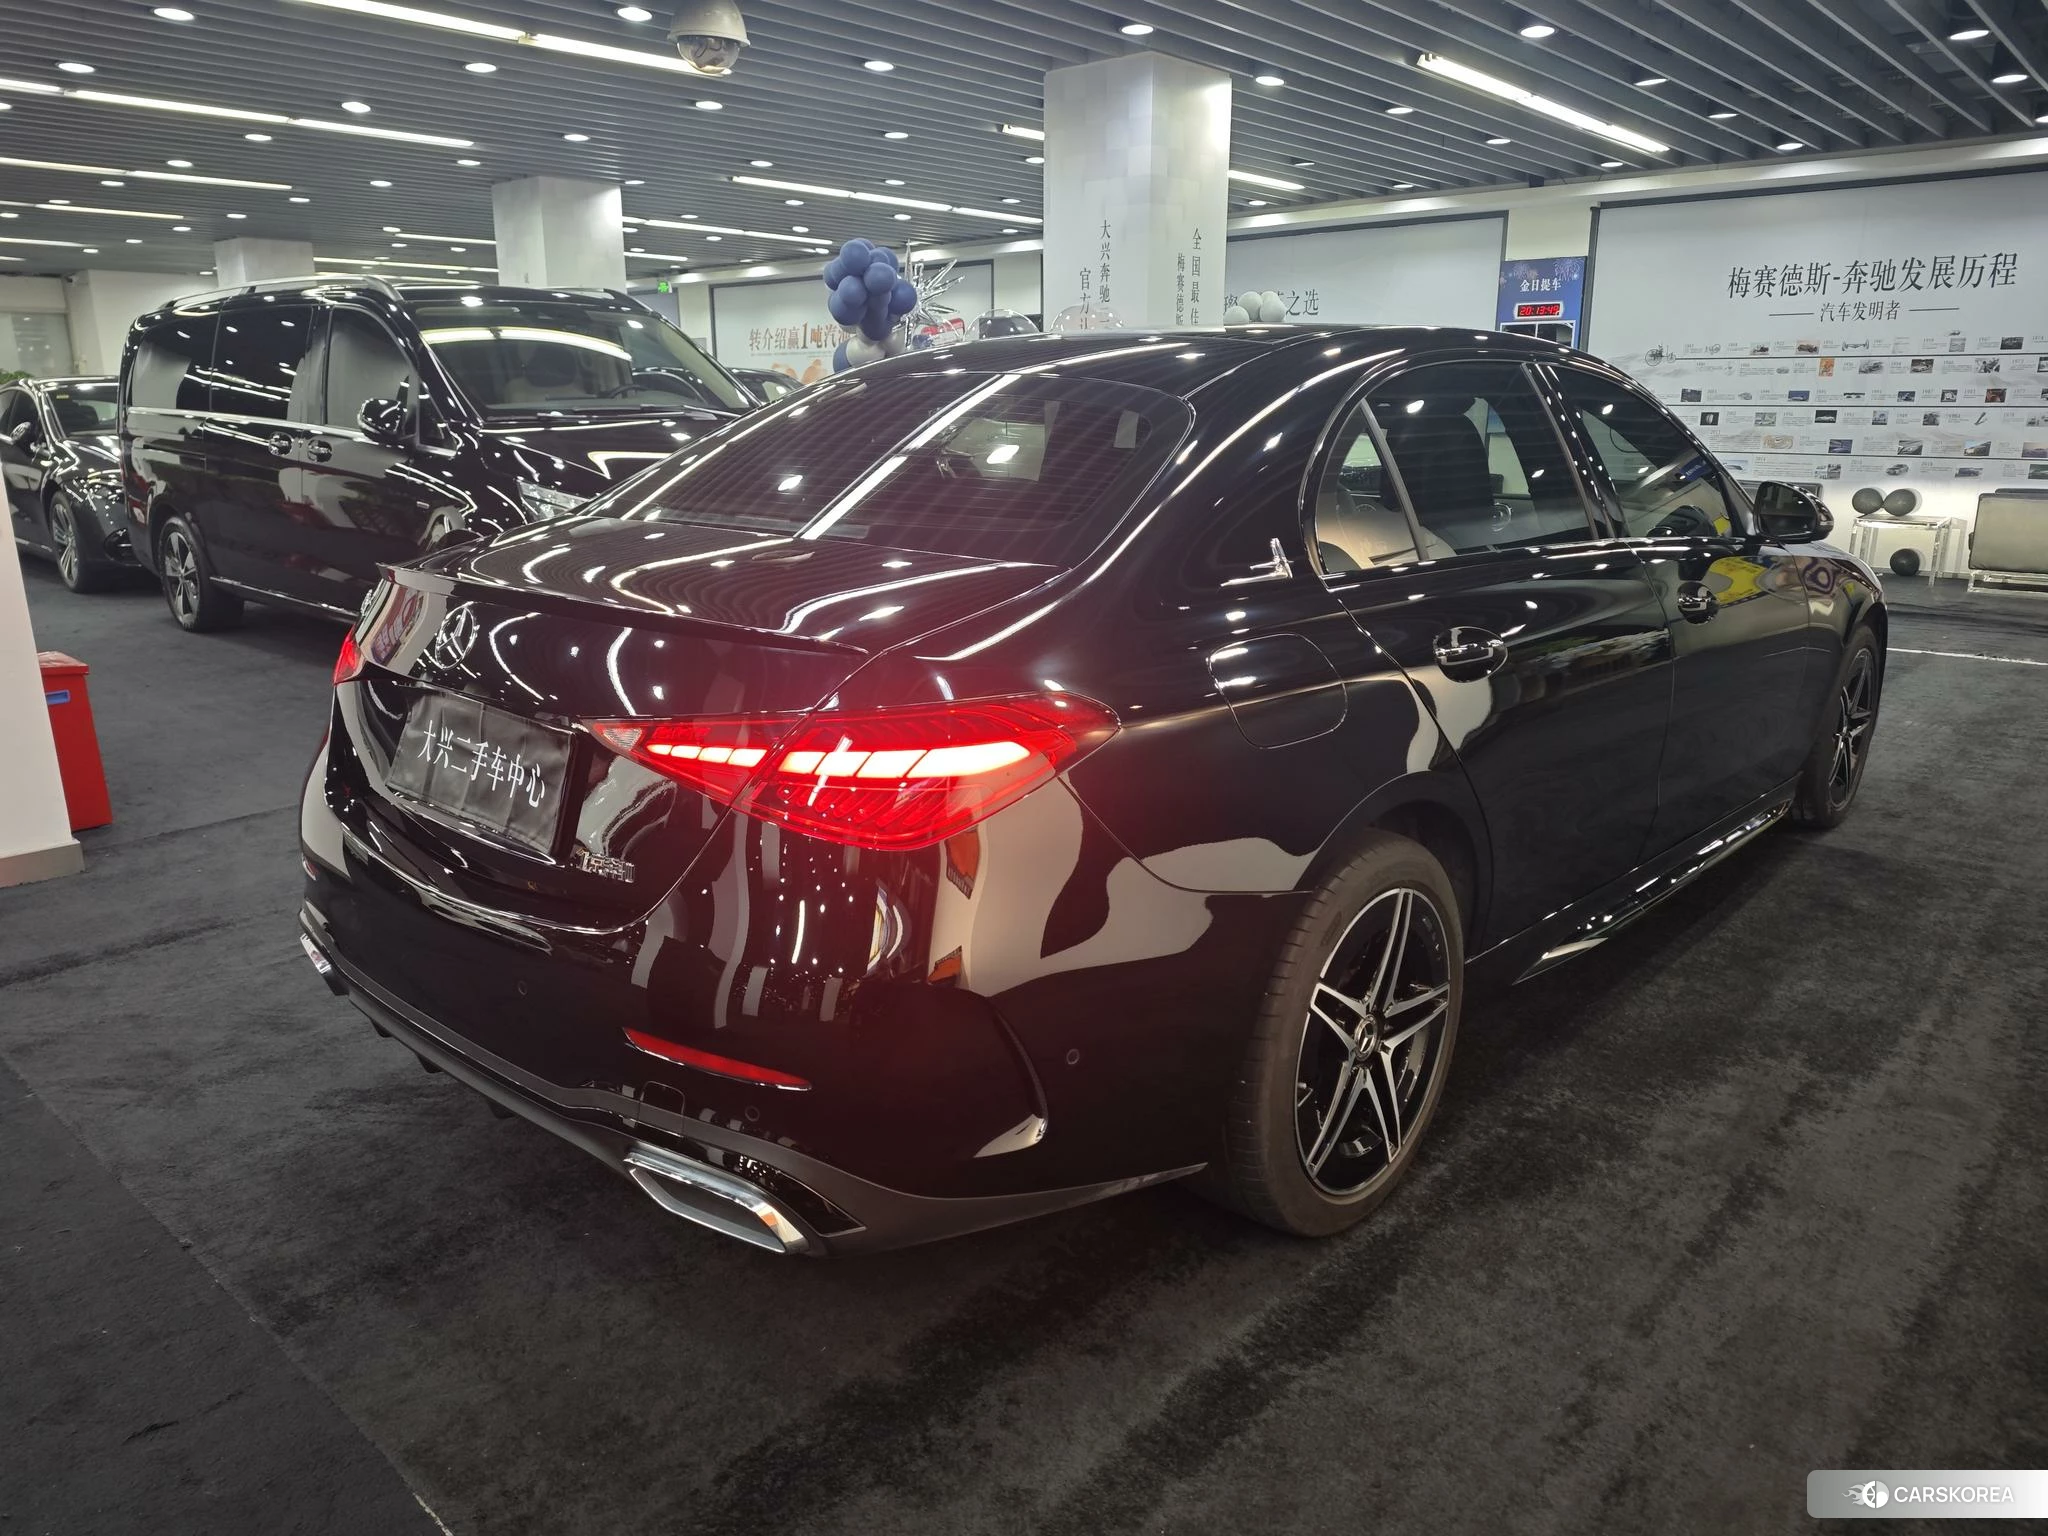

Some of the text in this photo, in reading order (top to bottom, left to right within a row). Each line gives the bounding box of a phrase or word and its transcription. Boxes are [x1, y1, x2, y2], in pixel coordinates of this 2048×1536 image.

[1727, 251, 2019, 299] 梅赛德斯-奔驰发展历程
[1820, 300, 1901, 322] 汽车发明者
[416, 719, 546, 808] 大兴二手车中心
